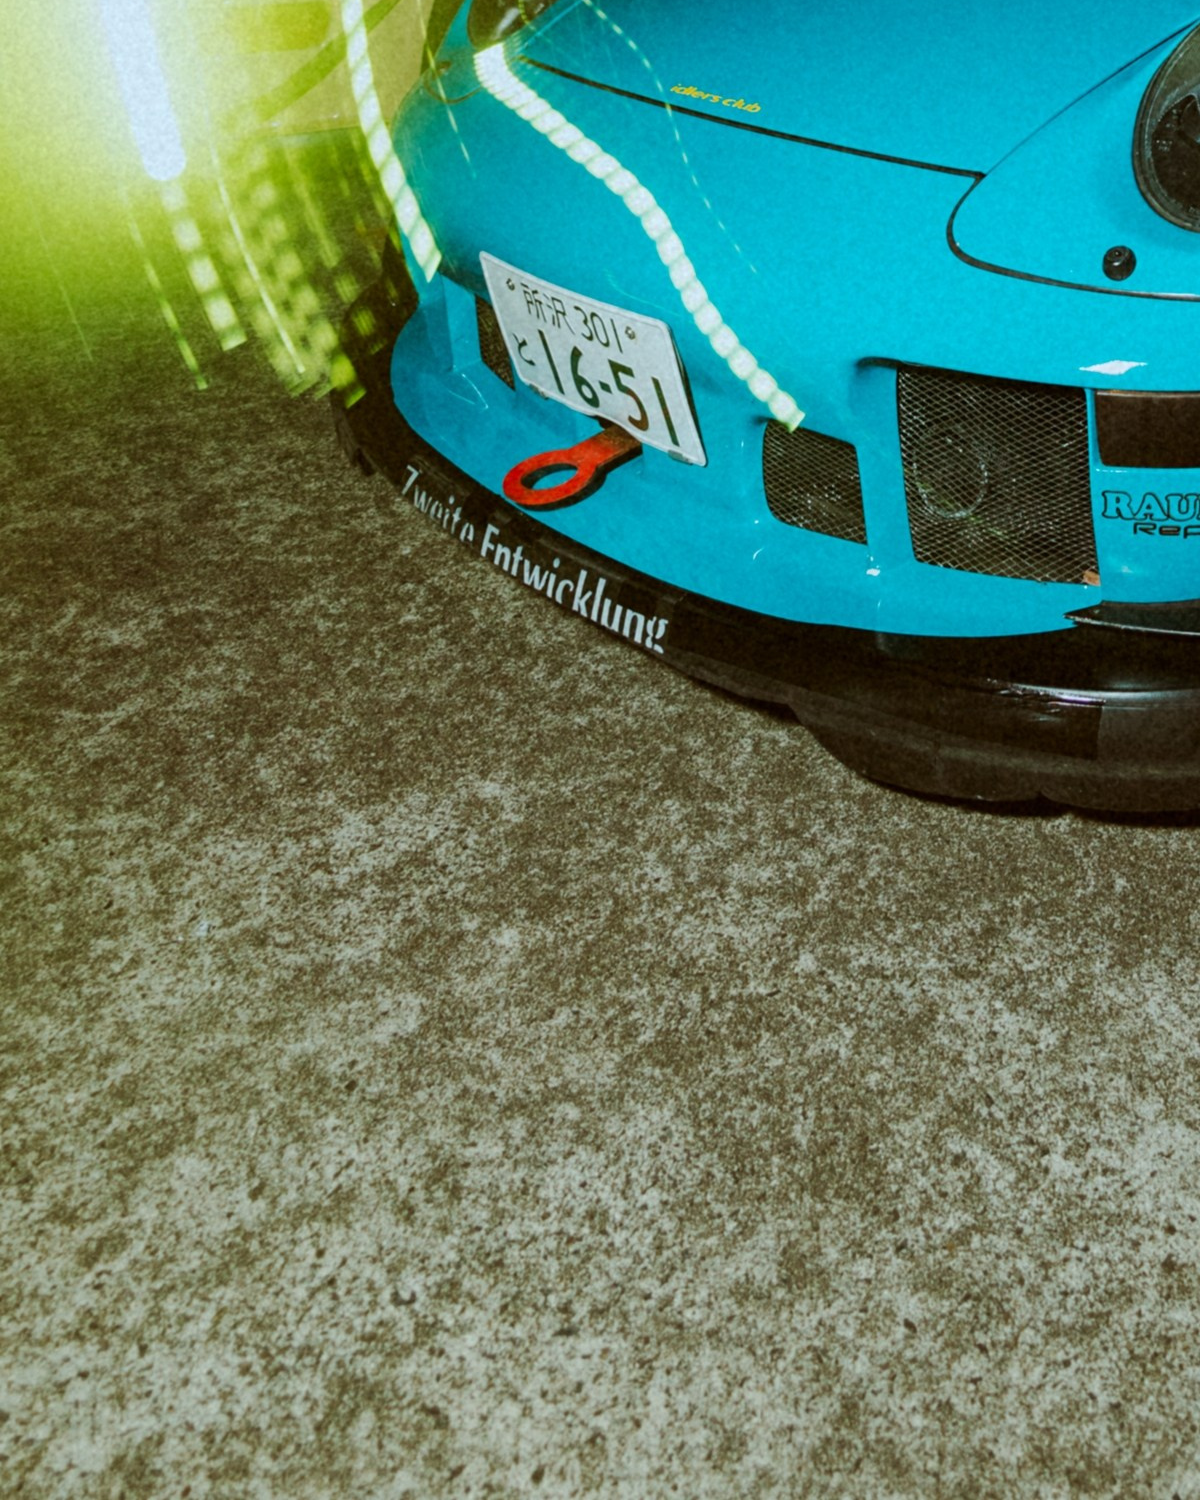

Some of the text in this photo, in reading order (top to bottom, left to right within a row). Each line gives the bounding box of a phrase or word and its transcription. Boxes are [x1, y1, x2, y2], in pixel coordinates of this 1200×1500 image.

[721, 97, 762, 114] club
[520, 282, 625, 354] 所沢 301
[480, 523, 670, 655] Entwicklung
